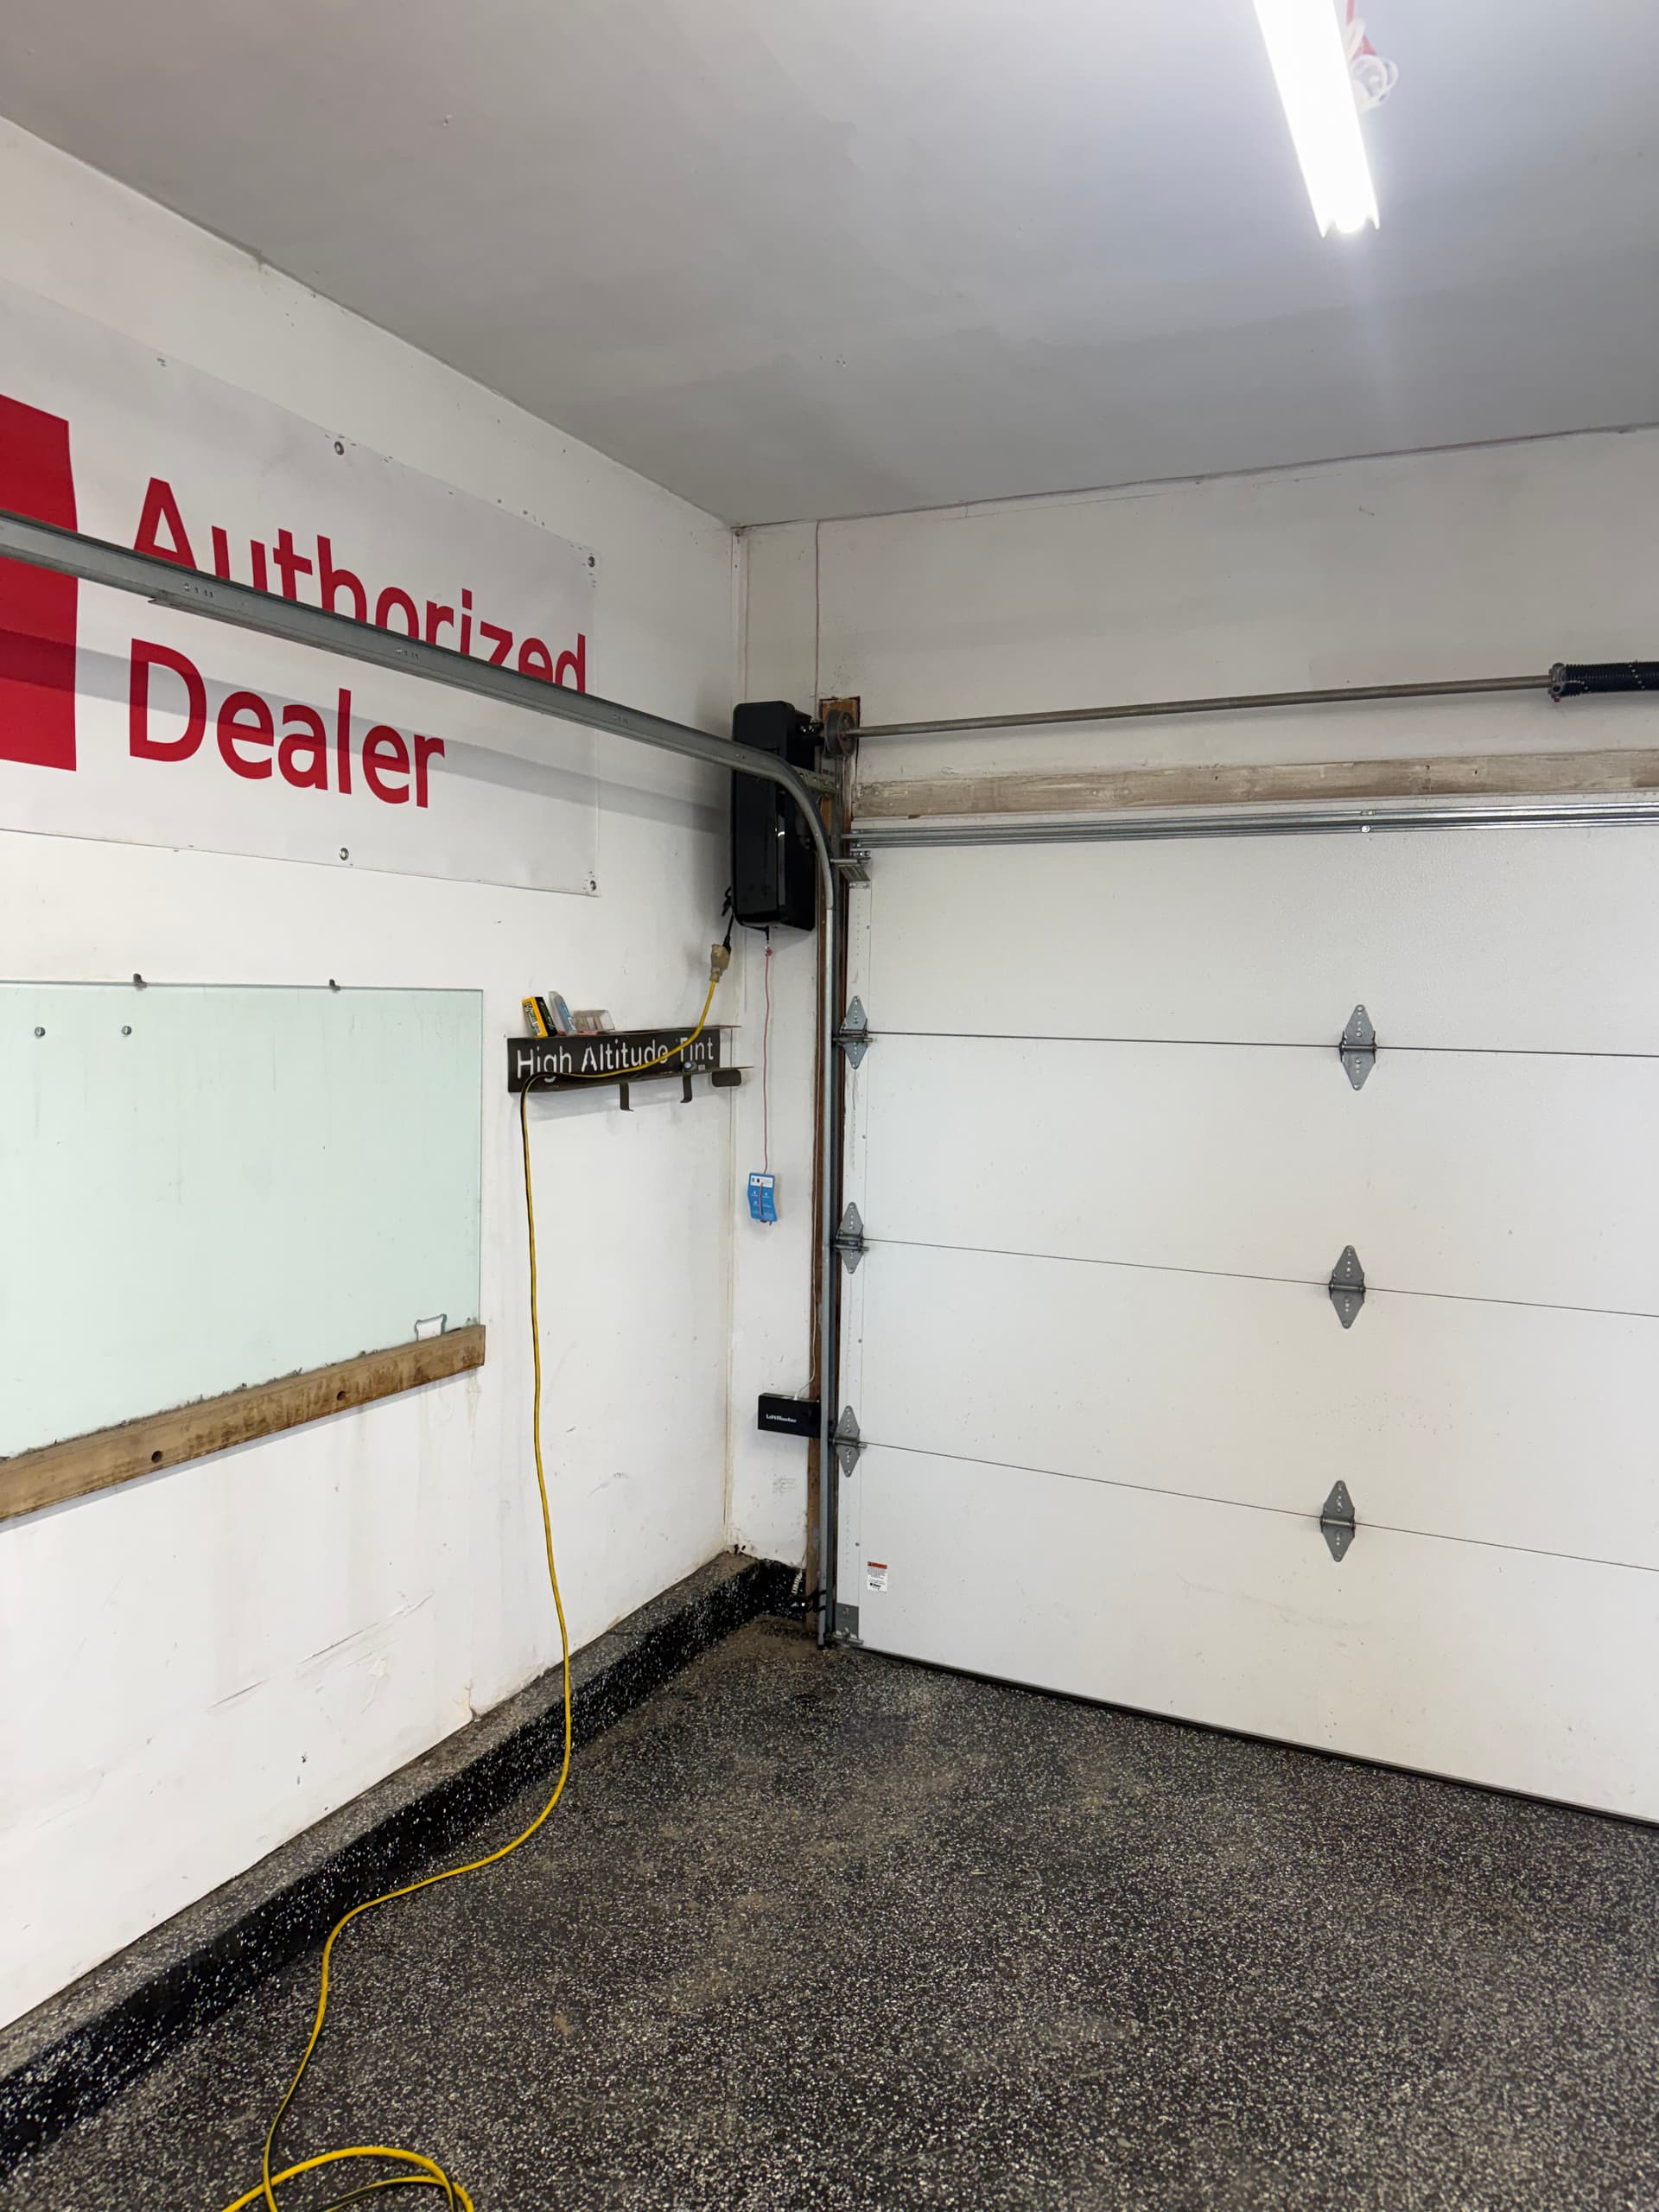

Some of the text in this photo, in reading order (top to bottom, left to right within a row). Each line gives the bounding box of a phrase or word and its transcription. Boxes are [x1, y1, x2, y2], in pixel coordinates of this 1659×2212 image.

[133, 477, 587, 694] Authorized
[129, 638, 445, 809] Dealer
[517, 1036, 715, 1084] High Altitude Tint
